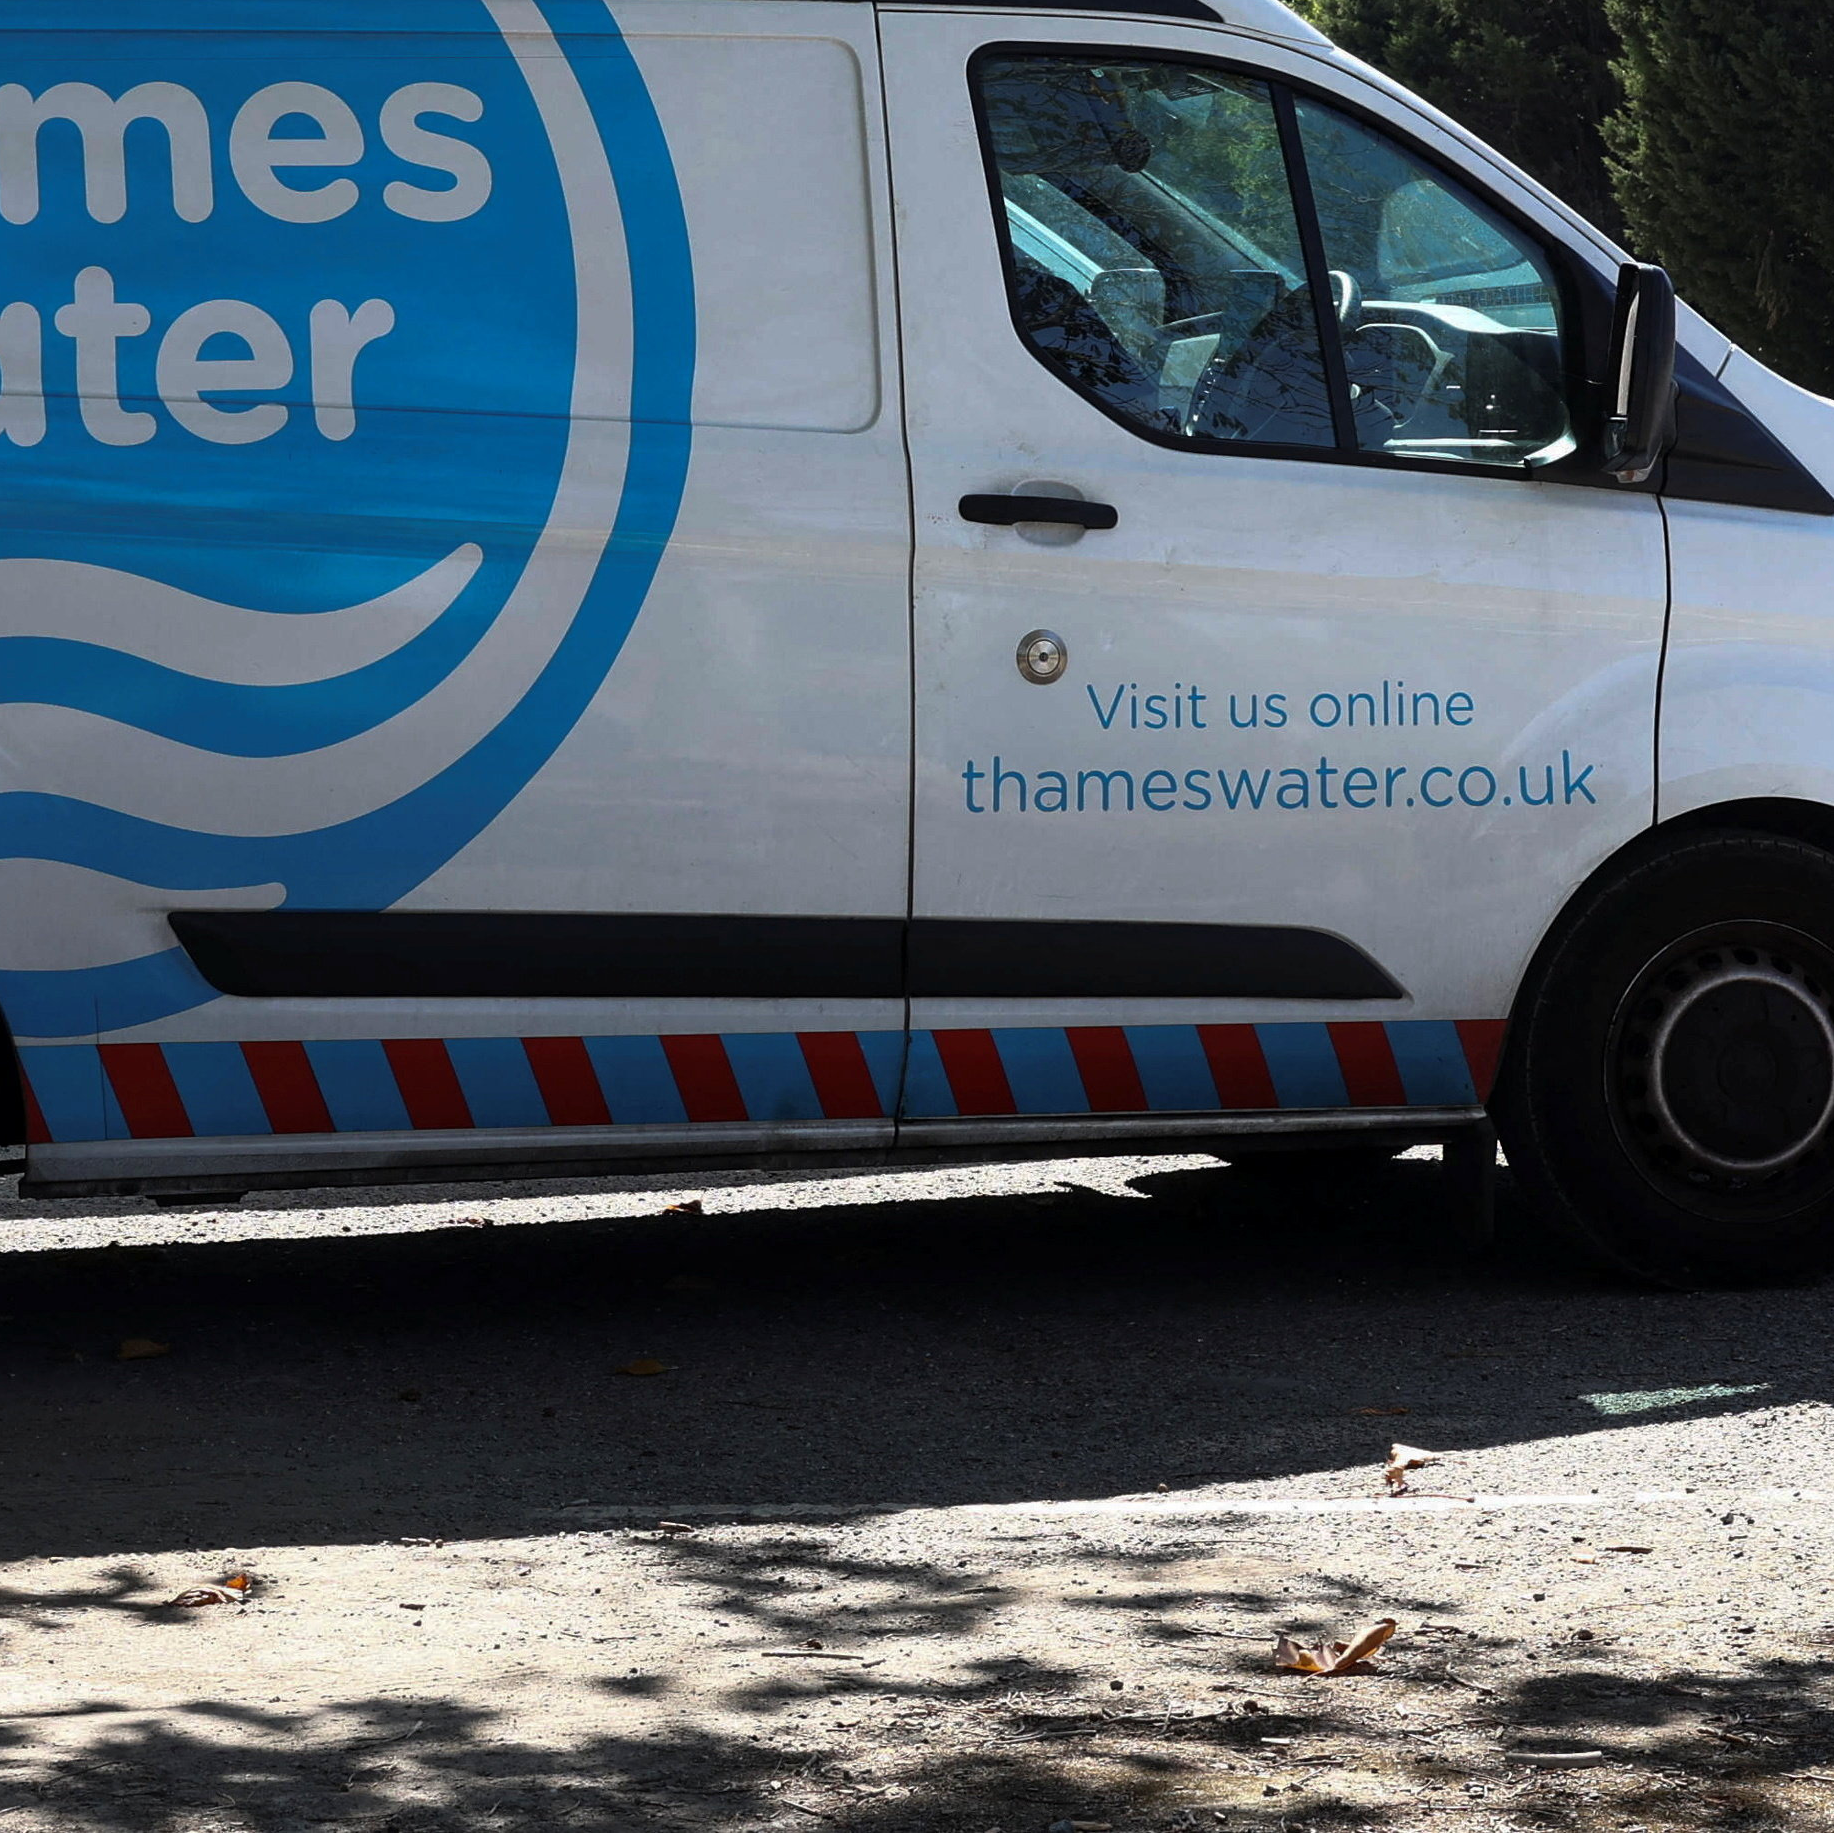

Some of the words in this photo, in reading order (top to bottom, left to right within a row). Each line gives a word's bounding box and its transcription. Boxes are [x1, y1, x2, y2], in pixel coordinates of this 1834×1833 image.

[1086, 682, 1207, 730] Visit
[1230, 695, 1288, 728] us
[1310, 682, 1475, 728] online
[962, 750, 1597, 814] thameswater.co.uk
